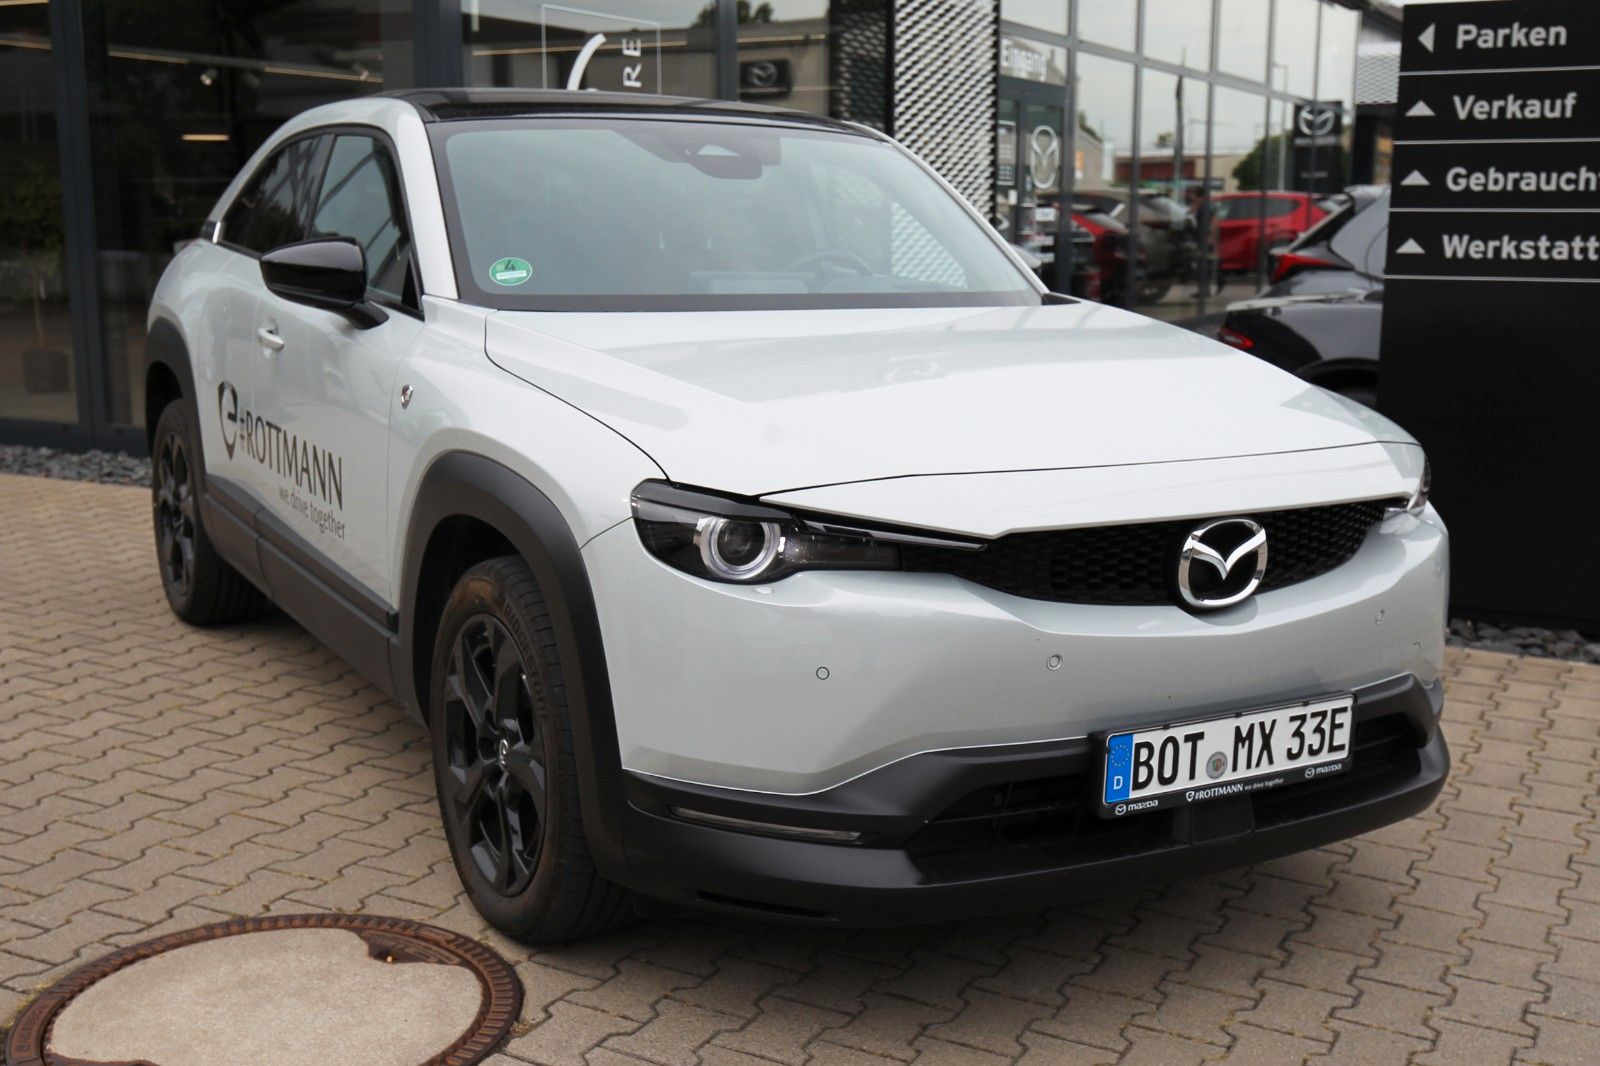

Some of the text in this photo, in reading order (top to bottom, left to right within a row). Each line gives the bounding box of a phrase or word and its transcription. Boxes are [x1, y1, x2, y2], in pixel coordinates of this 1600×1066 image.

[1456, 22, 1567, 49] Parken
[1453, 92, 1577, 120] Verkauf
[1446, 165, 1600, 192] Gebrauch
[1442, 234, 1600, 261] Werkstatt
[246, 409, 344, 511] ROTTMANN
[310, 501, 345, 541] together
[1131, 706, 1349, 792] BOT MX 33E
[1113, 775, 1123, 790] D
